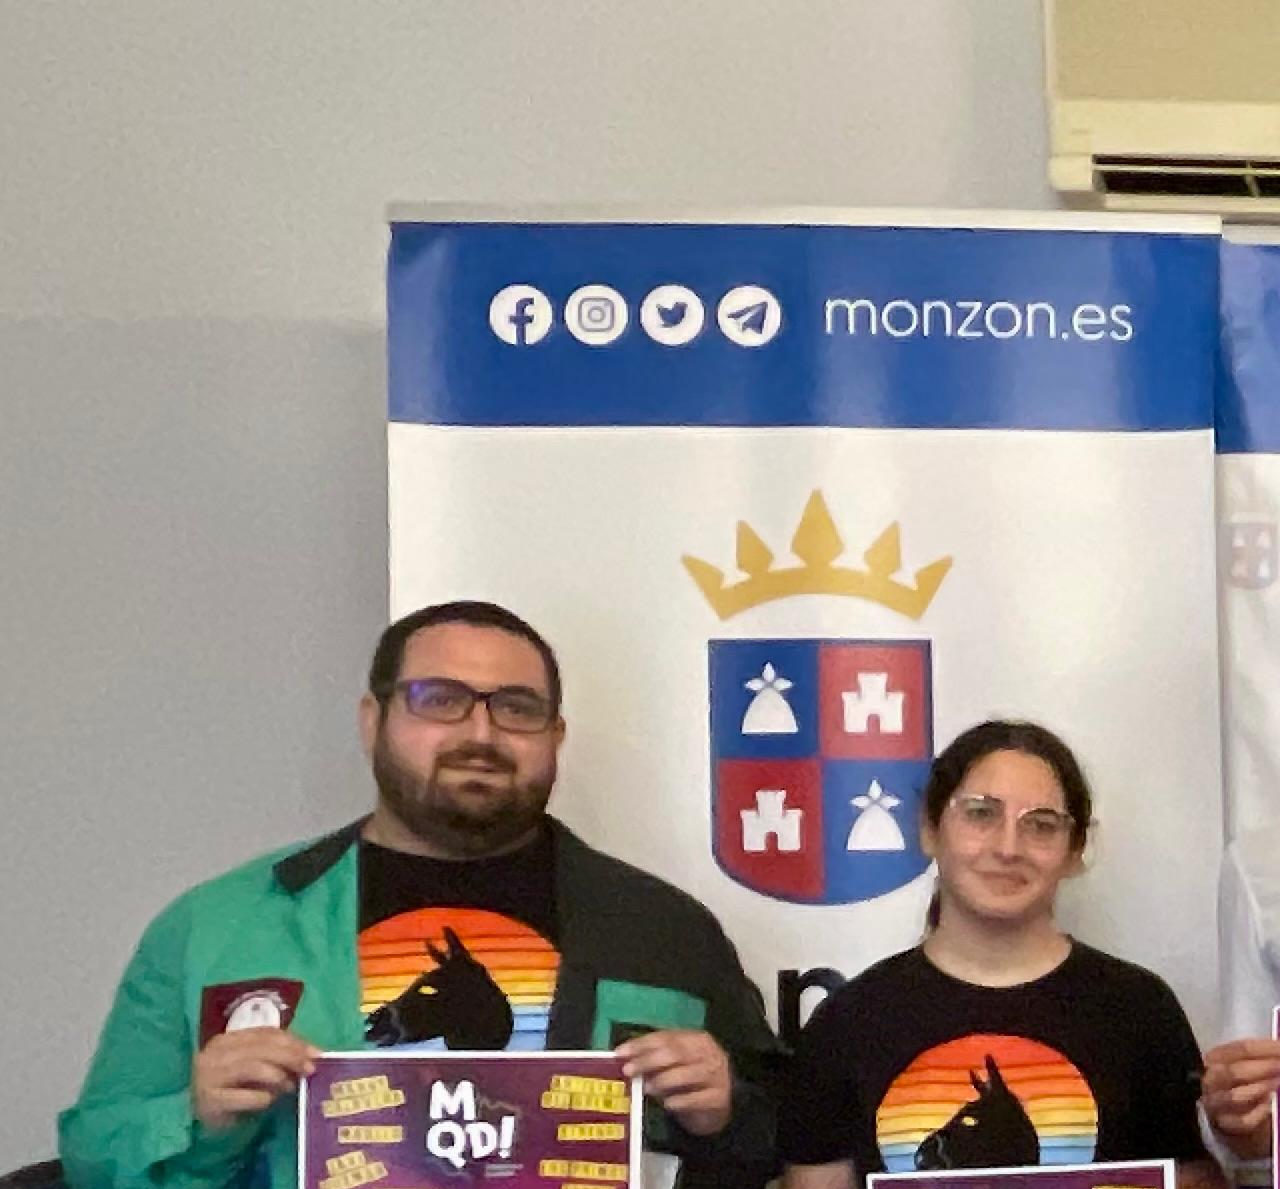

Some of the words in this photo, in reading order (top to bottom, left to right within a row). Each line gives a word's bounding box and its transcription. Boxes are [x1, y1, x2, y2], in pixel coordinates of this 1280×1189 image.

[823, 295, 1135, 343] monzon.es
[430, 1080, 478, 1121] M
[426, 1115, 515, 1169] QD!
